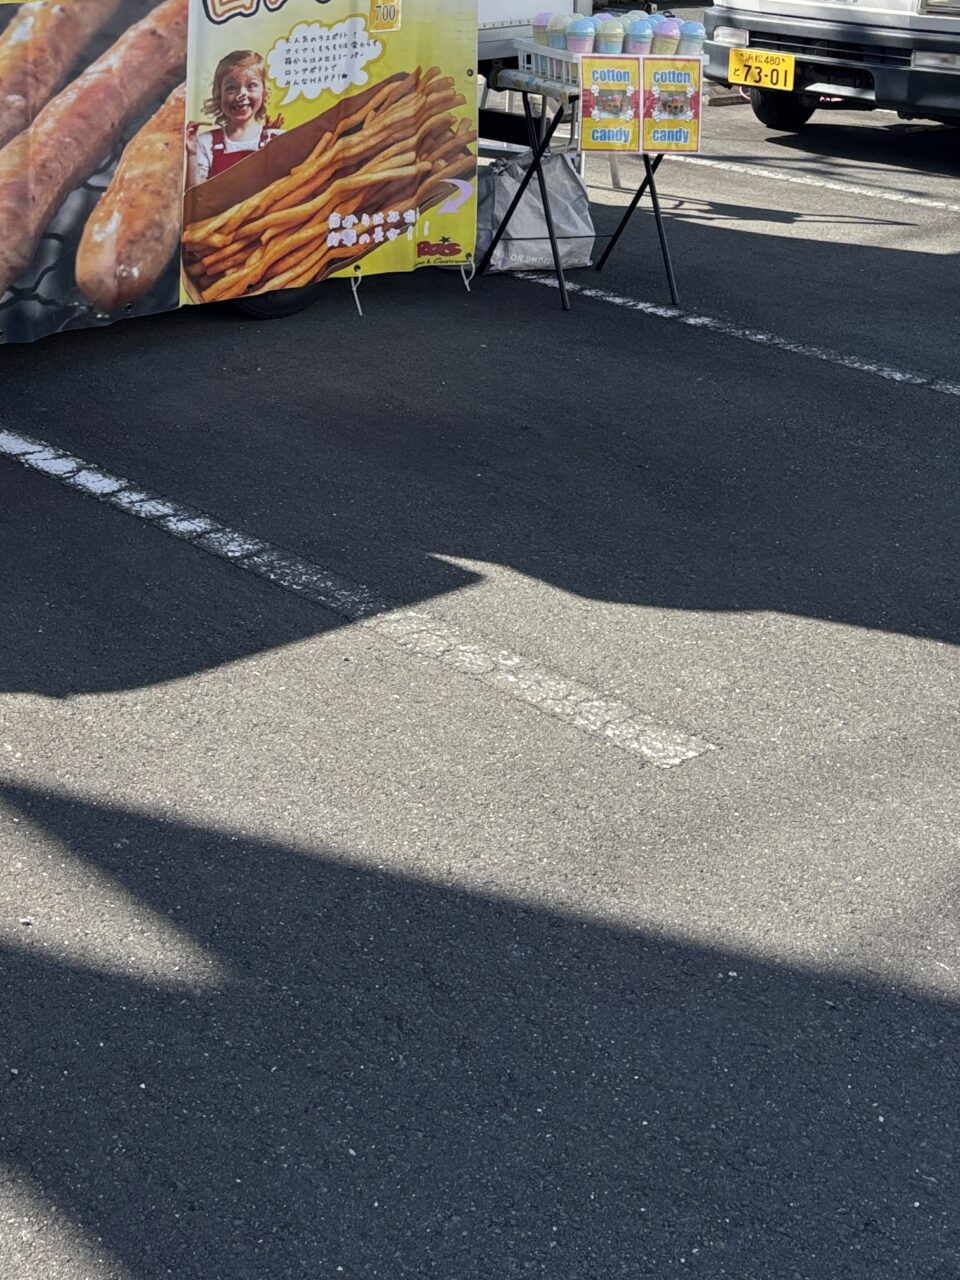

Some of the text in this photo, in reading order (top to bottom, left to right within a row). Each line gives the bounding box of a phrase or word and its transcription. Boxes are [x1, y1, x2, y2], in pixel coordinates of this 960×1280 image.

[375, 4, 395, 21] 700
[591, 69, 630, 82] cotton
[743, 64, 788, 87] 73-01
[591, 128, 629, 143] candy
[652, 128, 689, 143] candy
